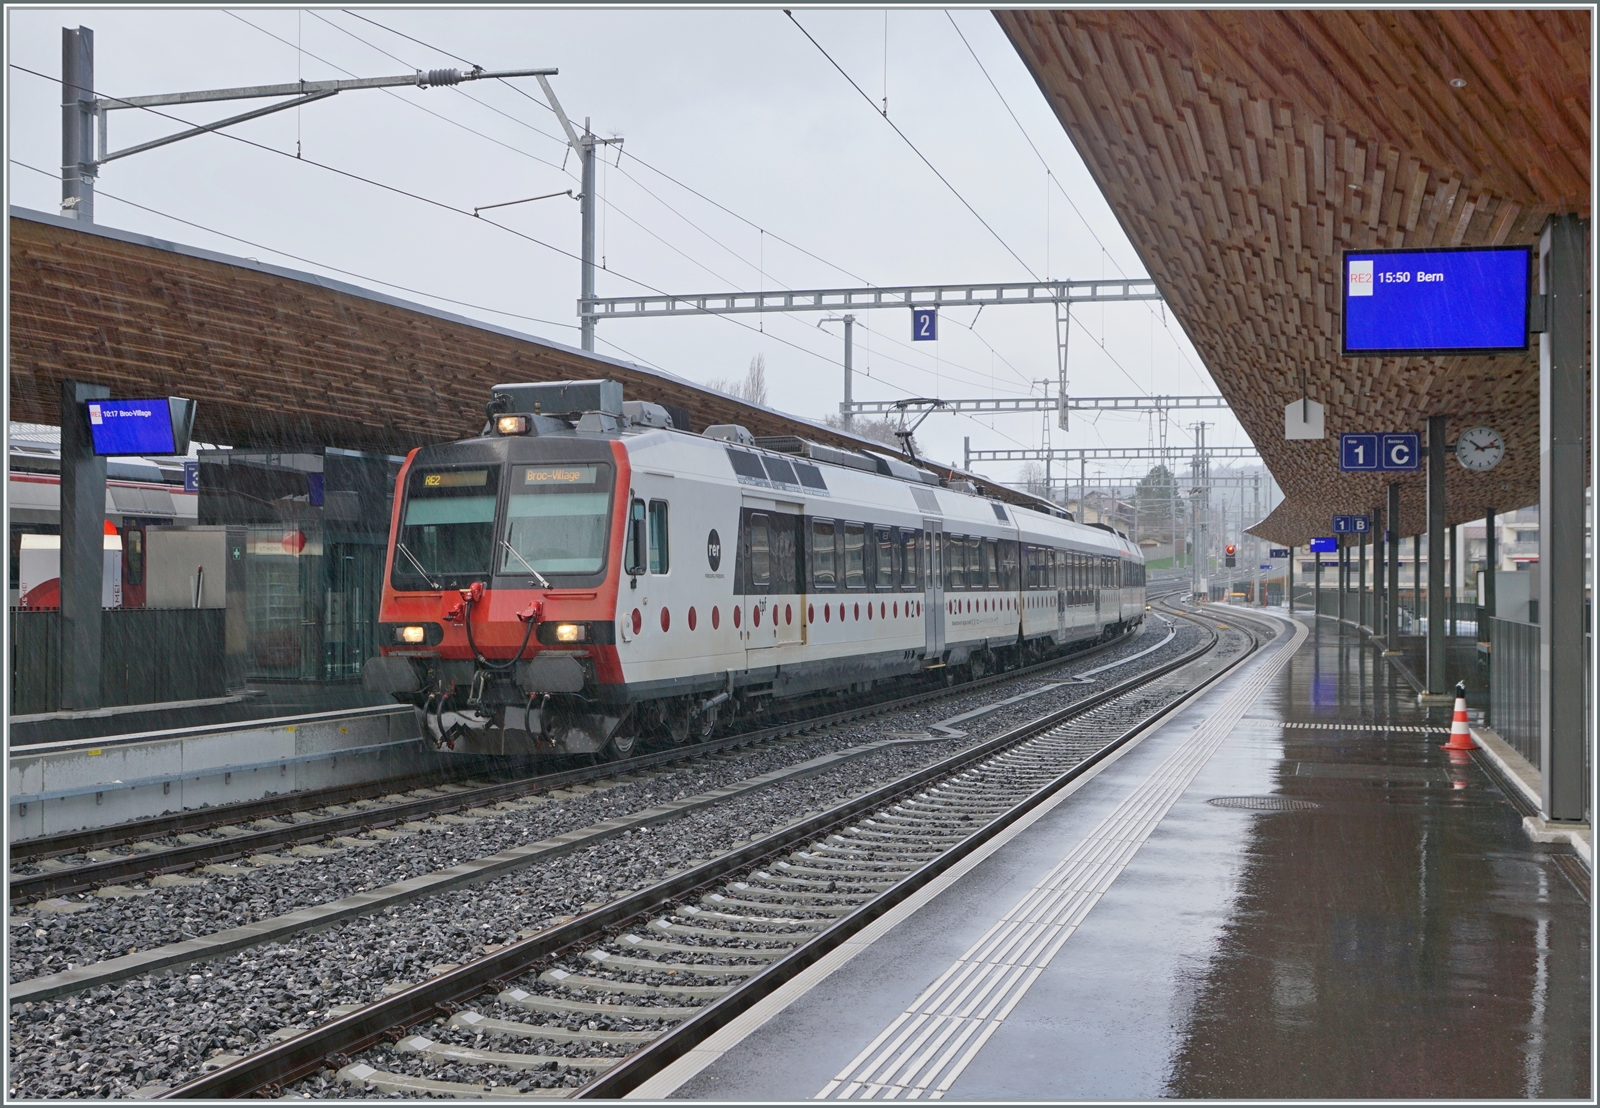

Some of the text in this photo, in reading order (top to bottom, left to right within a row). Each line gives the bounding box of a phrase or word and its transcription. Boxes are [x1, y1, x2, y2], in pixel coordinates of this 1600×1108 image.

[1350, 271, 1444, 283] RE2 15:50 Bern
[920, 314, 930, 336] 2
[119, 409, 152, 418] Broc-Village
[1354, 444, 1410, 465] 1 C
[425, 475, 441, 486] RE2
[527, 471, 580, 482] Broc-Village
[1339, 520, 1365, 530] 1 B
[708, 544, 720, 556] rer
